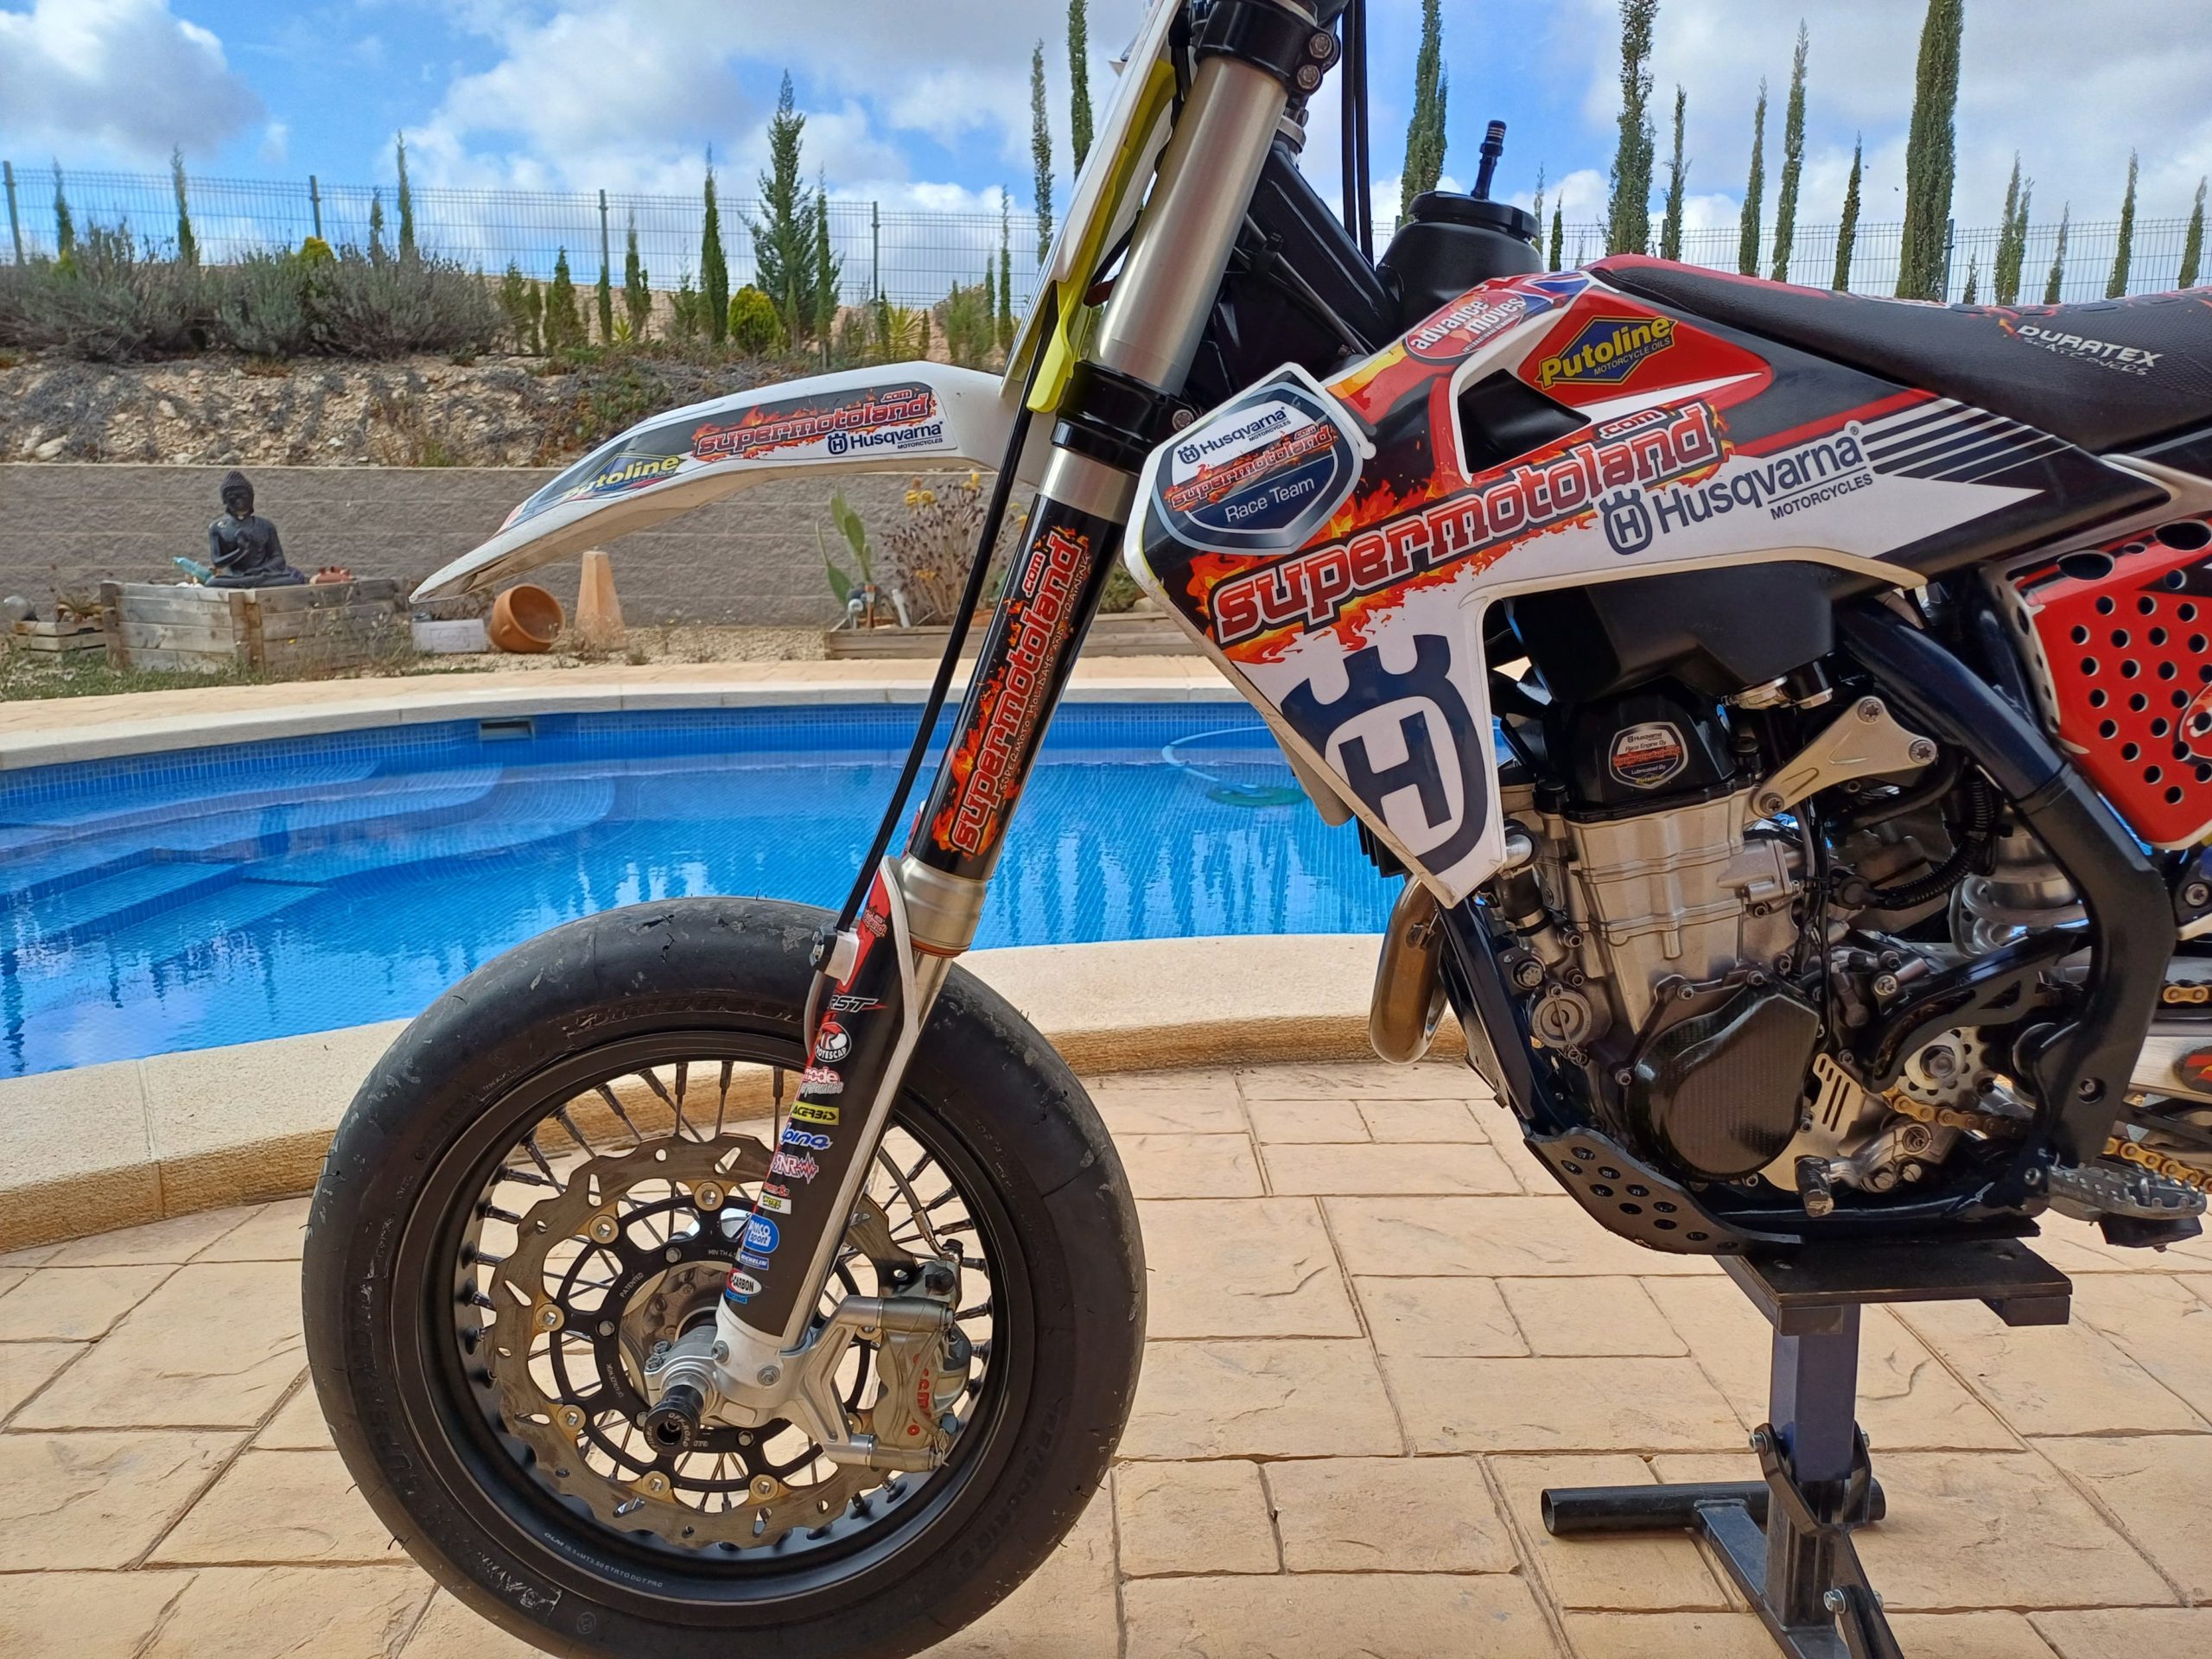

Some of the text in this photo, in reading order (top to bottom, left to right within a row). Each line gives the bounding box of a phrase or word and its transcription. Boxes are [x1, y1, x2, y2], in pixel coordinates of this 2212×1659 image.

[1410, 299, 1490, 350] advance
[1464, 298, 1527, 335] moves
[1541, 317, 1671, 387] Putoline
[1594, 337, 1671, 376] MOTORCYCLE OILS
[2018, 325, 2164, 367] DURATEX
[697, 394, 930, 455] supermotoland
[851, 422, 942, 449] Husqvarna
[897, 438, 944, 449] MOTORCYCLES
[1200, 408, 1287, 455] Husqvarna
[1249, 420, 1291, 442] MOTORCYCLES
[1599, 405, 1664, 438] .com
[1171, 425, 1333, 508] supermotoland
[1651, 435, 1864, 537] Husqvarna
[1225, 478, 1314, 522] Race Team
[1770, 474, 1873, 520] MOTORCYCLES
[1212, 406, 1719, 644] supermotoland
[952, 531, 1086, 855] supermotoland
[999, 552, 1091, 794] SUPERMOTO HOLIDAYS AND TRAINING
[791, 1104, 836, 1121] ACERBIS
[750, 1233, 768, 1244] sport
[619, 1272, 644, 1298] PATENTED
